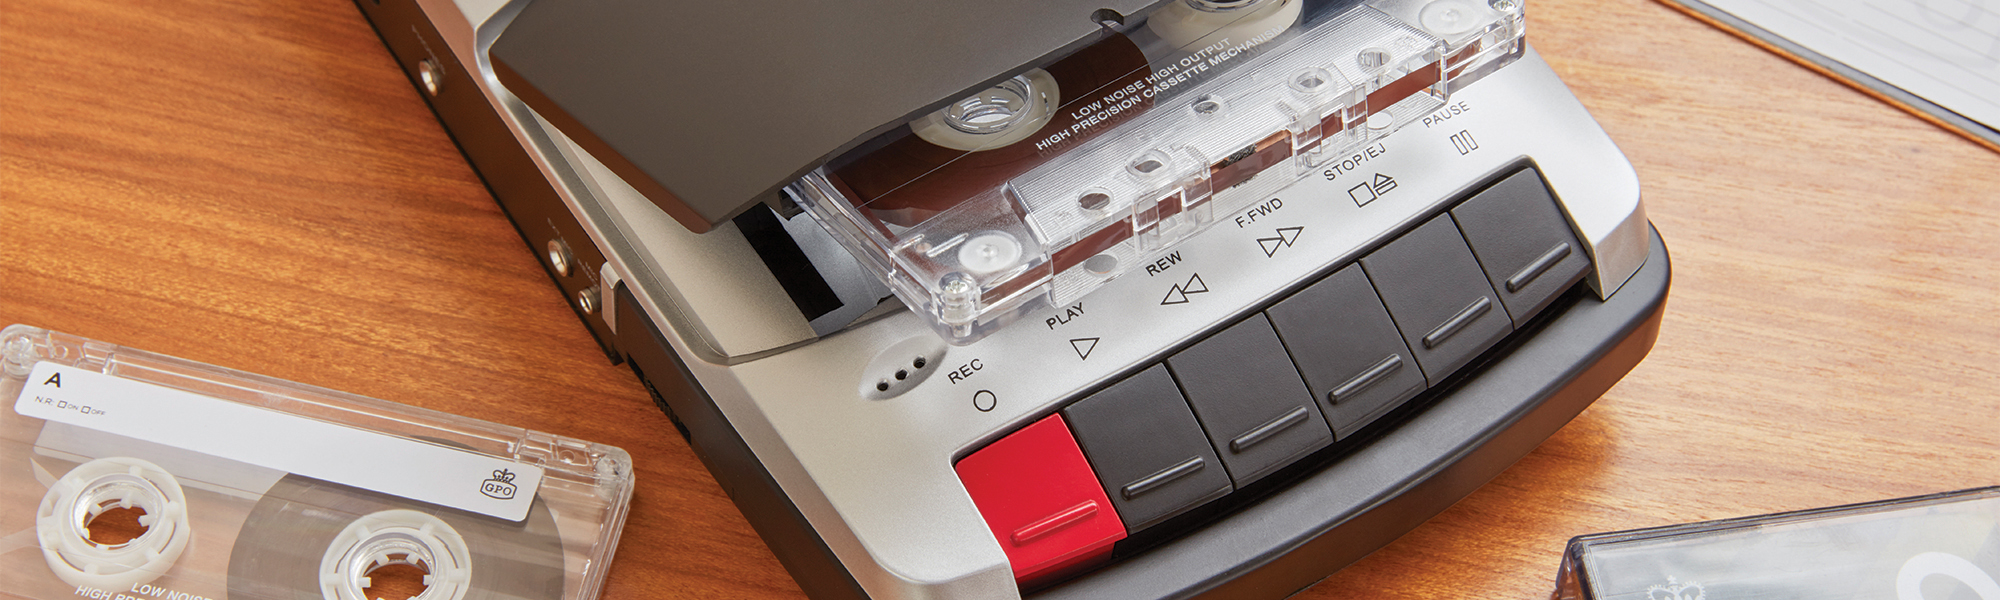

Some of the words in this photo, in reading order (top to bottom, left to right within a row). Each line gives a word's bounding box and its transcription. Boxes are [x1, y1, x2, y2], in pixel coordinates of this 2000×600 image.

[1035, 129, 1071, 151] HIGH
[1071, 95, 1142, 134] PRECISION
[1143, 62, 1209, 98] CASSETTE
[1208, 25, 1285, 67] MECHANISM
[1071, 100, 1102, 120] LOW
[1103, 80, 1146, 105] NOISE
[1145, 64, 1179, 84] HIGH
[1180, 38, 1231, 67] OUTPUT
[1422, 101, 1470, 129] PAUSE
[1323, 142, 1386, 181] STOP/EJ
[1235, 197, 1283, 228] F.FWD
[1145, 250, 1182, 277] REW
[1045, 302, 1084, 331] PLAY
[43, 372, 61, 388] A
[947, 358, 983, 384] REC
[484, 483, 512, 496] GPO
[74, 585, 112, 600] HIGH
[130, 582, 167, 598] LOW
